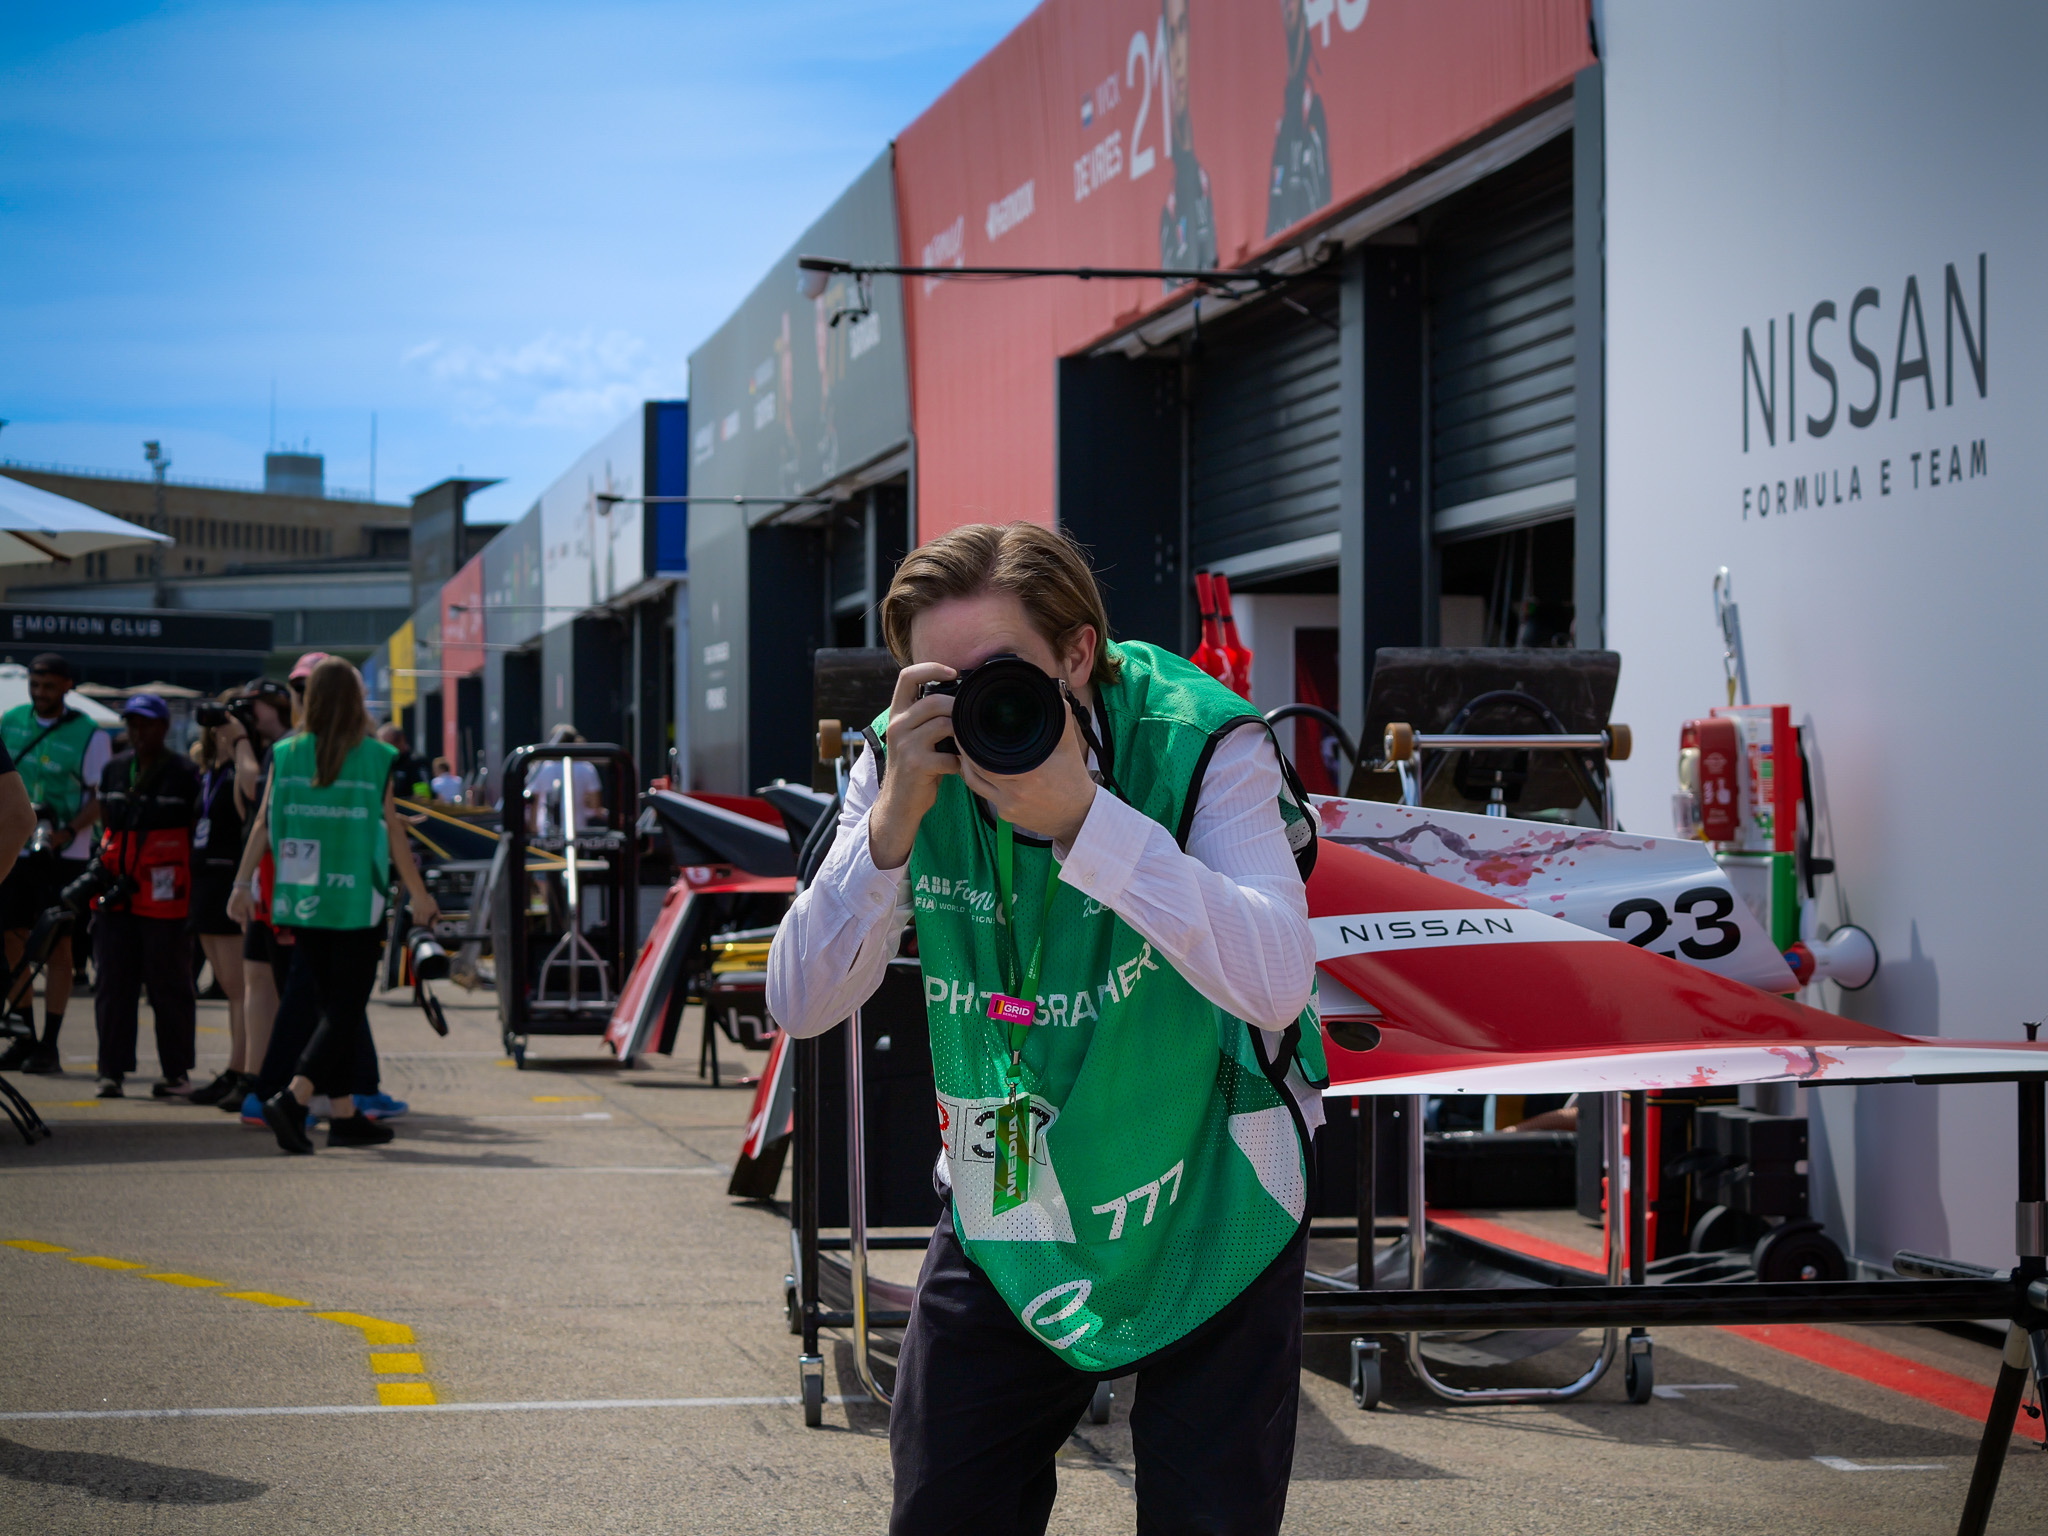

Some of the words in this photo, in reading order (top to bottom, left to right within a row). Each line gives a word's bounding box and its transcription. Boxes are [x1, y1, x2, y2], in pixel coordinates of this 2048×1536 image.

[1126, 15, 1172, 180] 21
[1742, 252, 1987, 453] NISSAN
[1743, 466, 1862, 521] FORMULA
[1880, 458, 1891, 496] E
[1910, 438, 1987, 490] TEAM
[12, 614, 105, 637] EMOTION
[110, 618, 162, 637] CLUB
[914, 896, 936, 910] FIA
[939, 902, 966, 913] WORLD
[915, 874, 951, 896] ABB
[1340, 917, 1514, 944] NISSAN
[1608, 886, 1741, 960] 23
[1004, 1004, 1030, 1016] GRID
[1007, 1115, 1018, 1197] MEDIA
[1091, 1158, 1184, 1240] 777
